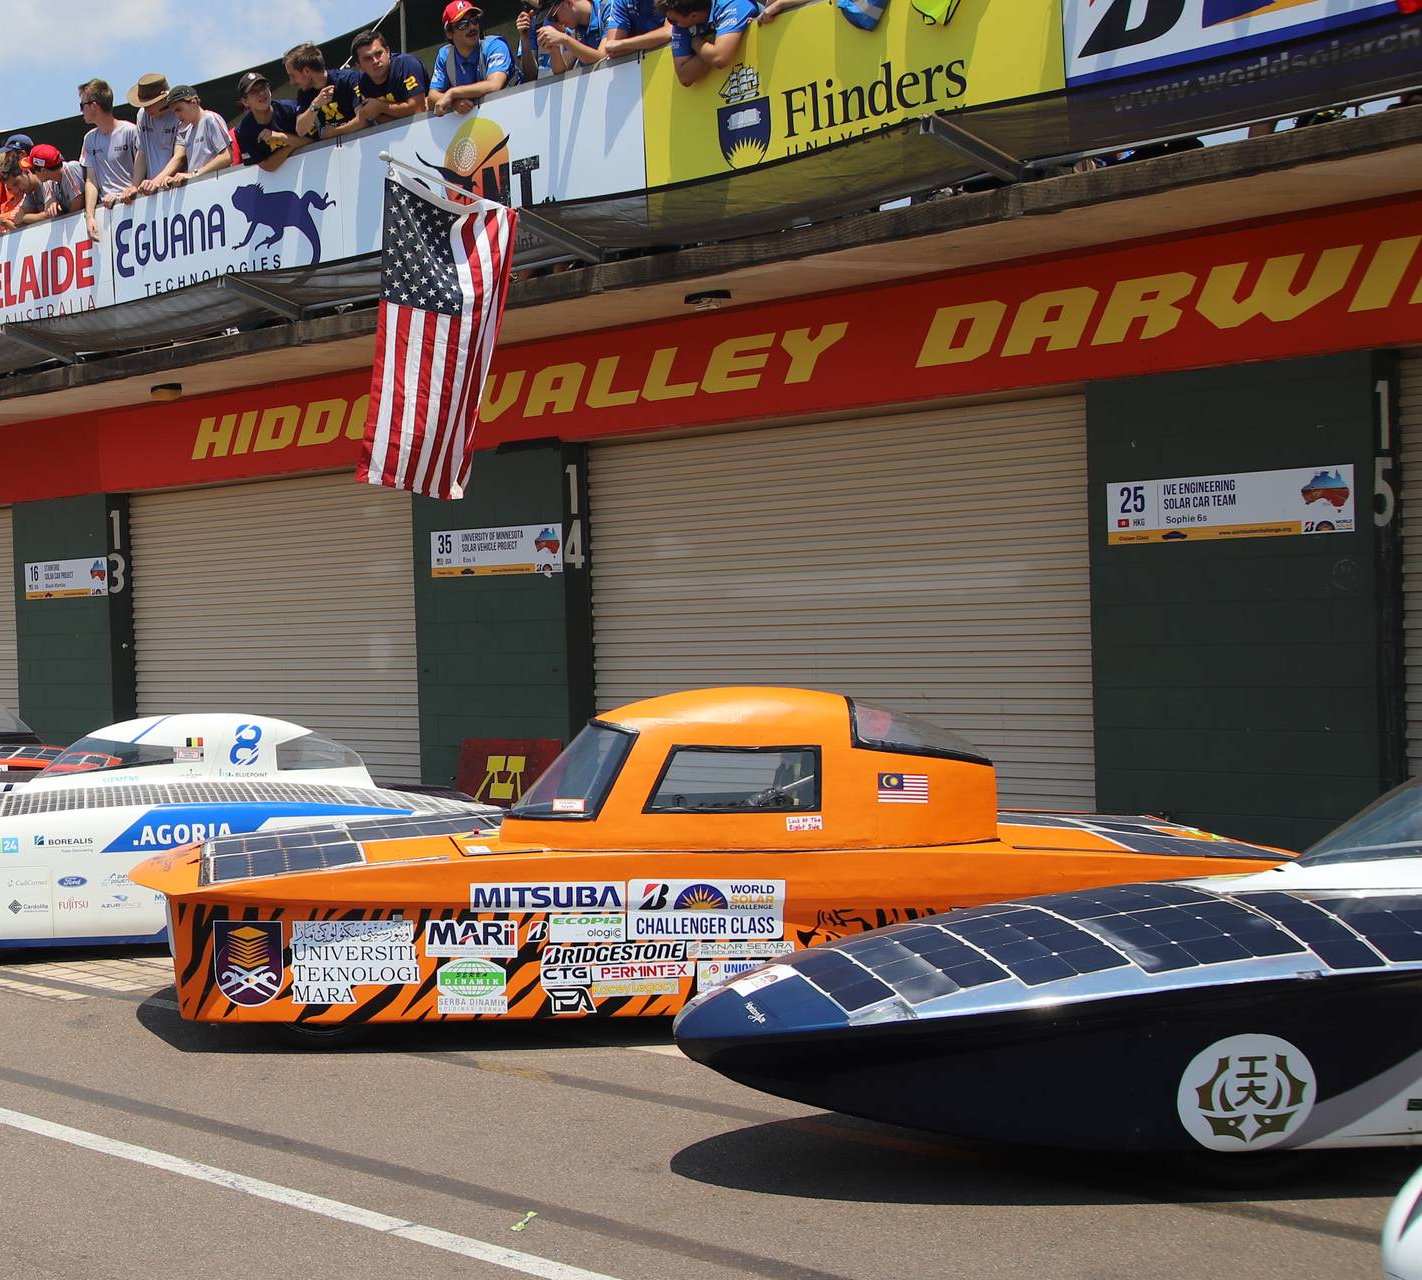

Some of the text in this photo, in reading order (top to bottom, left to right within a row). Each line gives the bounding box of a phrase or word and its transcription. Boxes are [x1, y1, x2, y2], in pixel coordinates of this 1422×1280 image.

[781, 59, 968, 139] Flinders
[115, 203, 226, 278] EGUANA
[144, 254, 282, 297] TECHNOLOGIES
[480, 321, 849, 424] VALLEY
[914, 234, 1422, 369] DARWI
[1162, 479, 1236, 496] IVE ENGINEERING
[1119, 486, 1146, 514] 25
[1163, 493, 1237, 511] SOLAR CAR TEAM
[1132, 518, 1146, 528] HKG
[1165, 513, 1208, 526] Sophie 6s
[437, 534, 453, 555] 35
[461, 529, 524, 543] UNIVERSITY OF MINNESOTA
[461, 540, 518, 553] SOLAR VEHICLE PROJECT
[30, 565, 39, 583] 16
[235, 771, 269, 779] BLUEPOINT
[3, 840, 17, 851] 24
[48, 837, 94, 846] BOREALIS
[473, 886, 623, 909] MITSUBA
[730, 884, 775, 894] WORLD
[58, 898, 89, 911] FUJITSU
[730, 894, 775, 905] SOLAR
[636, 916, 775, 935] CHALLENGER CLASS
[292, 943, 415, 961] UNIVERSITI
[542, 943, 684, 966] BRIDGESTONE
[700, 942, 793, 950] SYNAR SETARA
[293, 964, 420, 982] TEKNOLOGI
[543, 963, 688, 980] CTG PERMINTEX
[293, 985, 355, 1003] MARA
[438, 998, 506, 1007] SERBA DINAMIK
